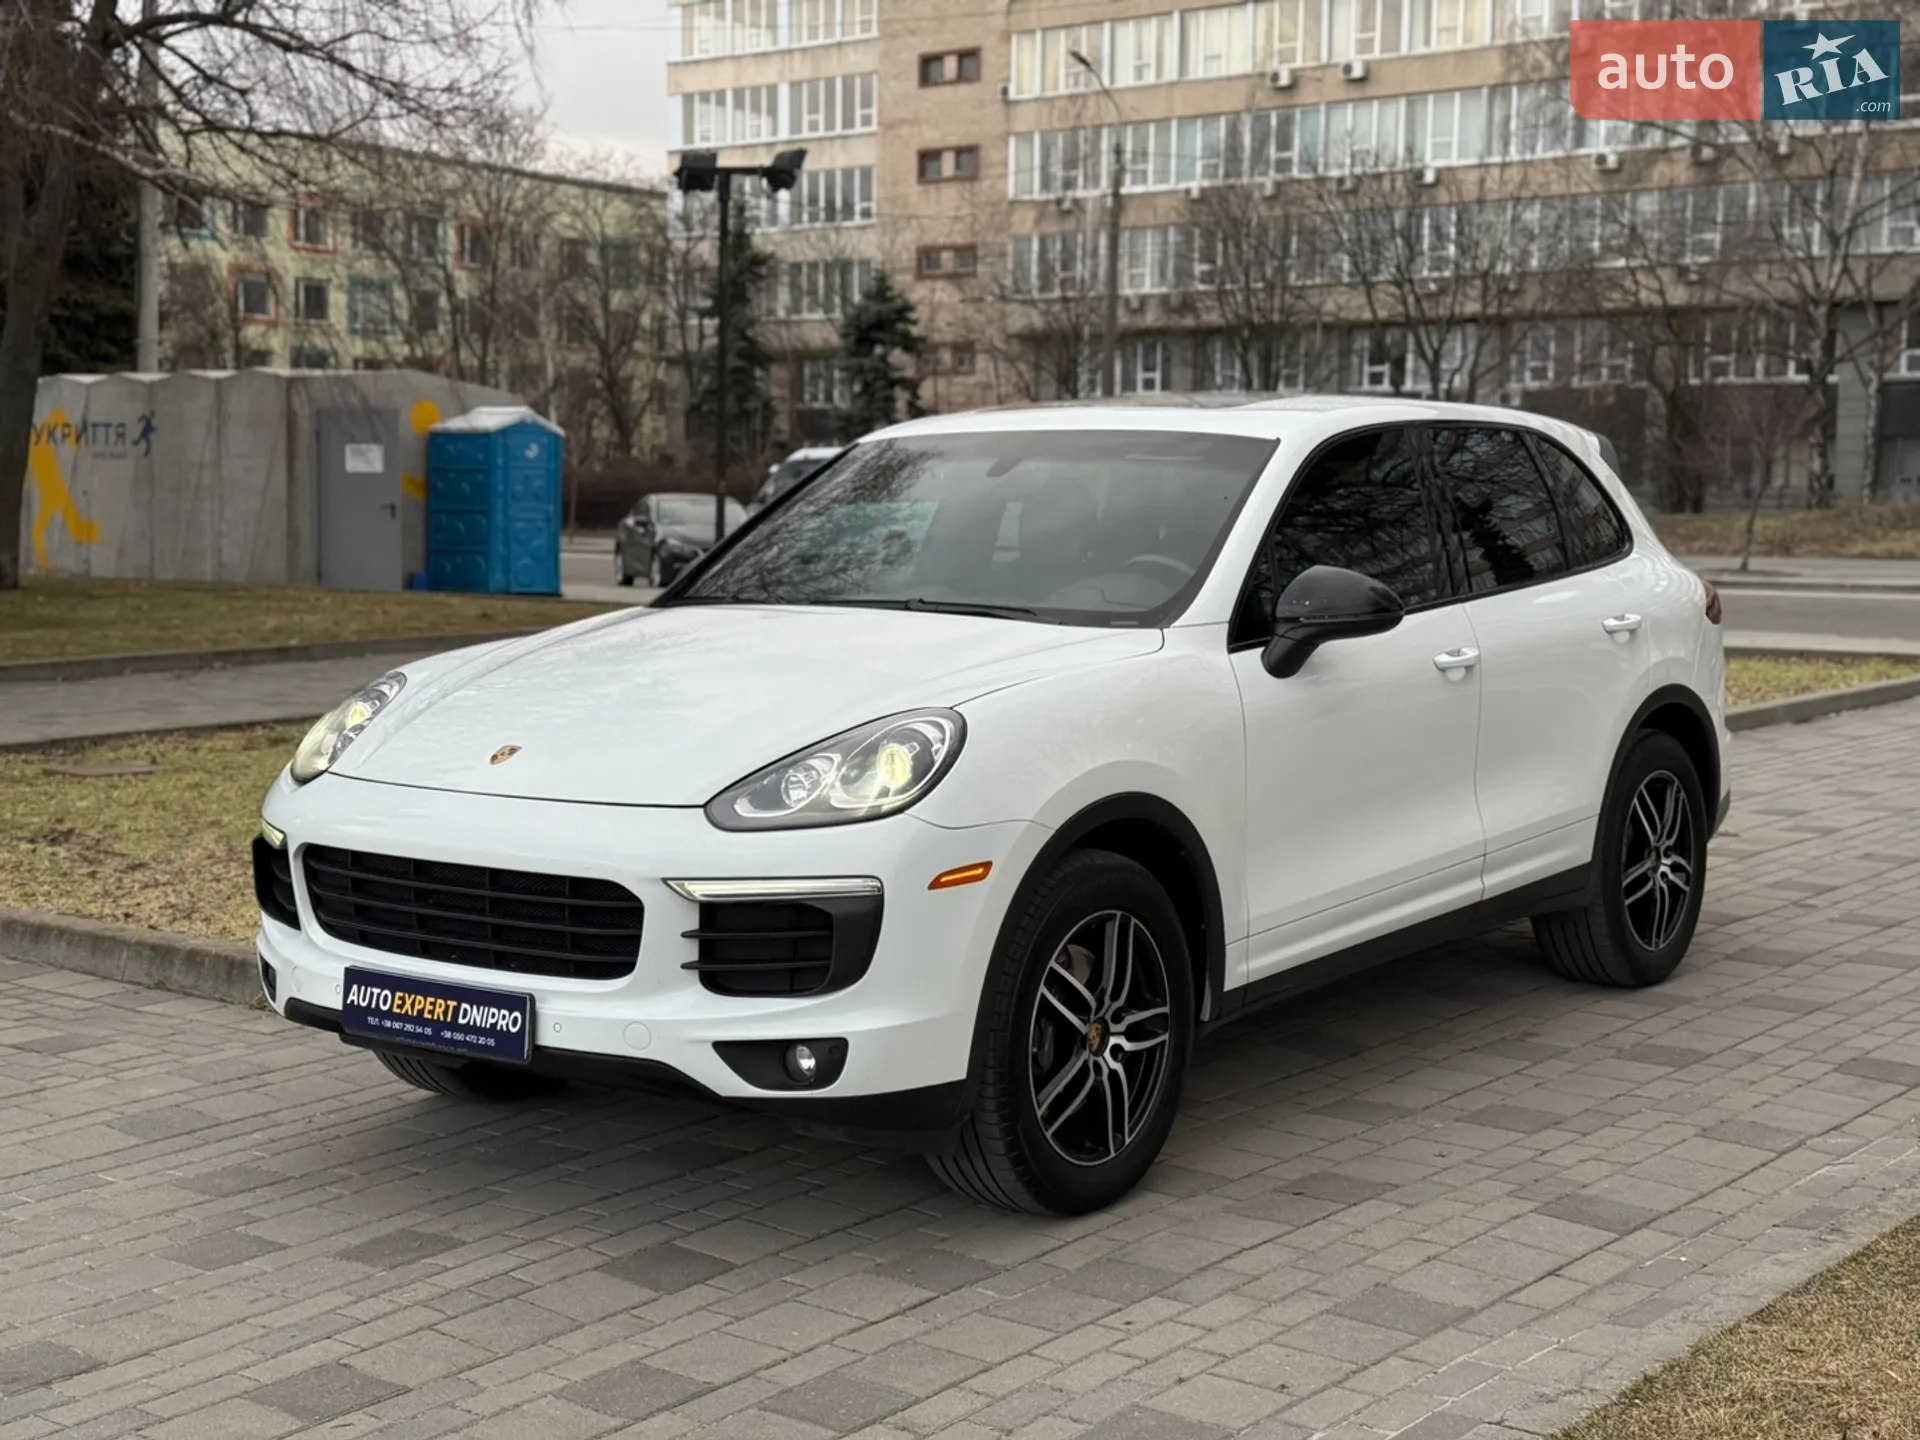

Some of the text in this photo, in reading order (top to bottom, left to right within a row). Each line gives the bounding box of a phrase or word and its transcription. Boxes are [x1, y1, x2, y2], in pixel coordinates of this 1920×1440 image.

[30, 421, 126, 446] УКРИТТЯ
[346, 984, 523, 1033] AUTO EXPERT DNIPRO
[381, 1019, 392, 1028] +38
